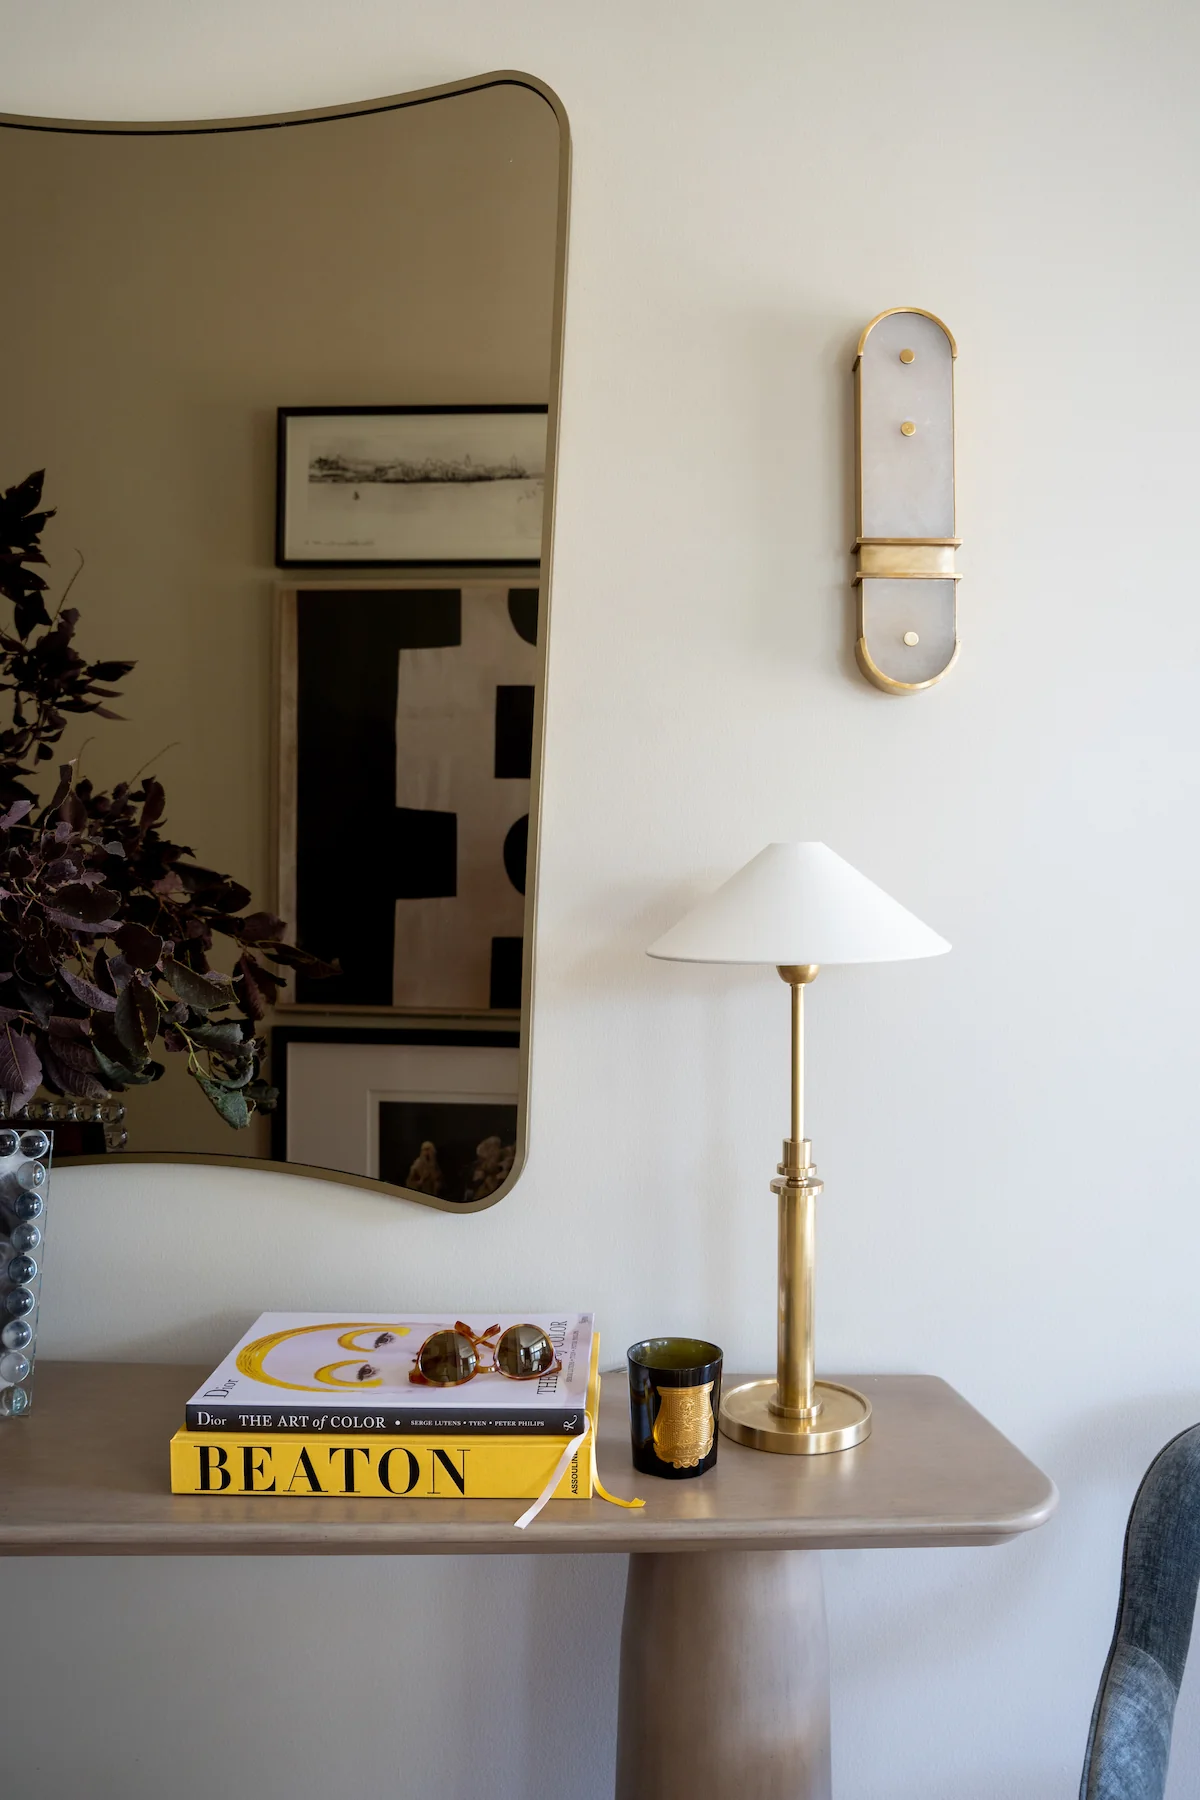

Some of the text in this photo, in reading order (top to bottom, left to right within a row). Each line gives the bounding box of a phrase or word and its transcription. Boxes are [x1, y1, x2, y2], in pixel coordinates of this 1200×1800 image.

[549, 1320, 568, 1348] COLOR
[203, 1379, 239, 1398] Dior
[197, 1411, 227, 1426] Dior
[239, 1414, 273, 1427] THE
[277, 1415, 309, 1428] ART
[312, 1414, 328, 1431] of
[331, 1415, 386, 1429] COLOR
[194, 1445, 471, 1496] BEATON
